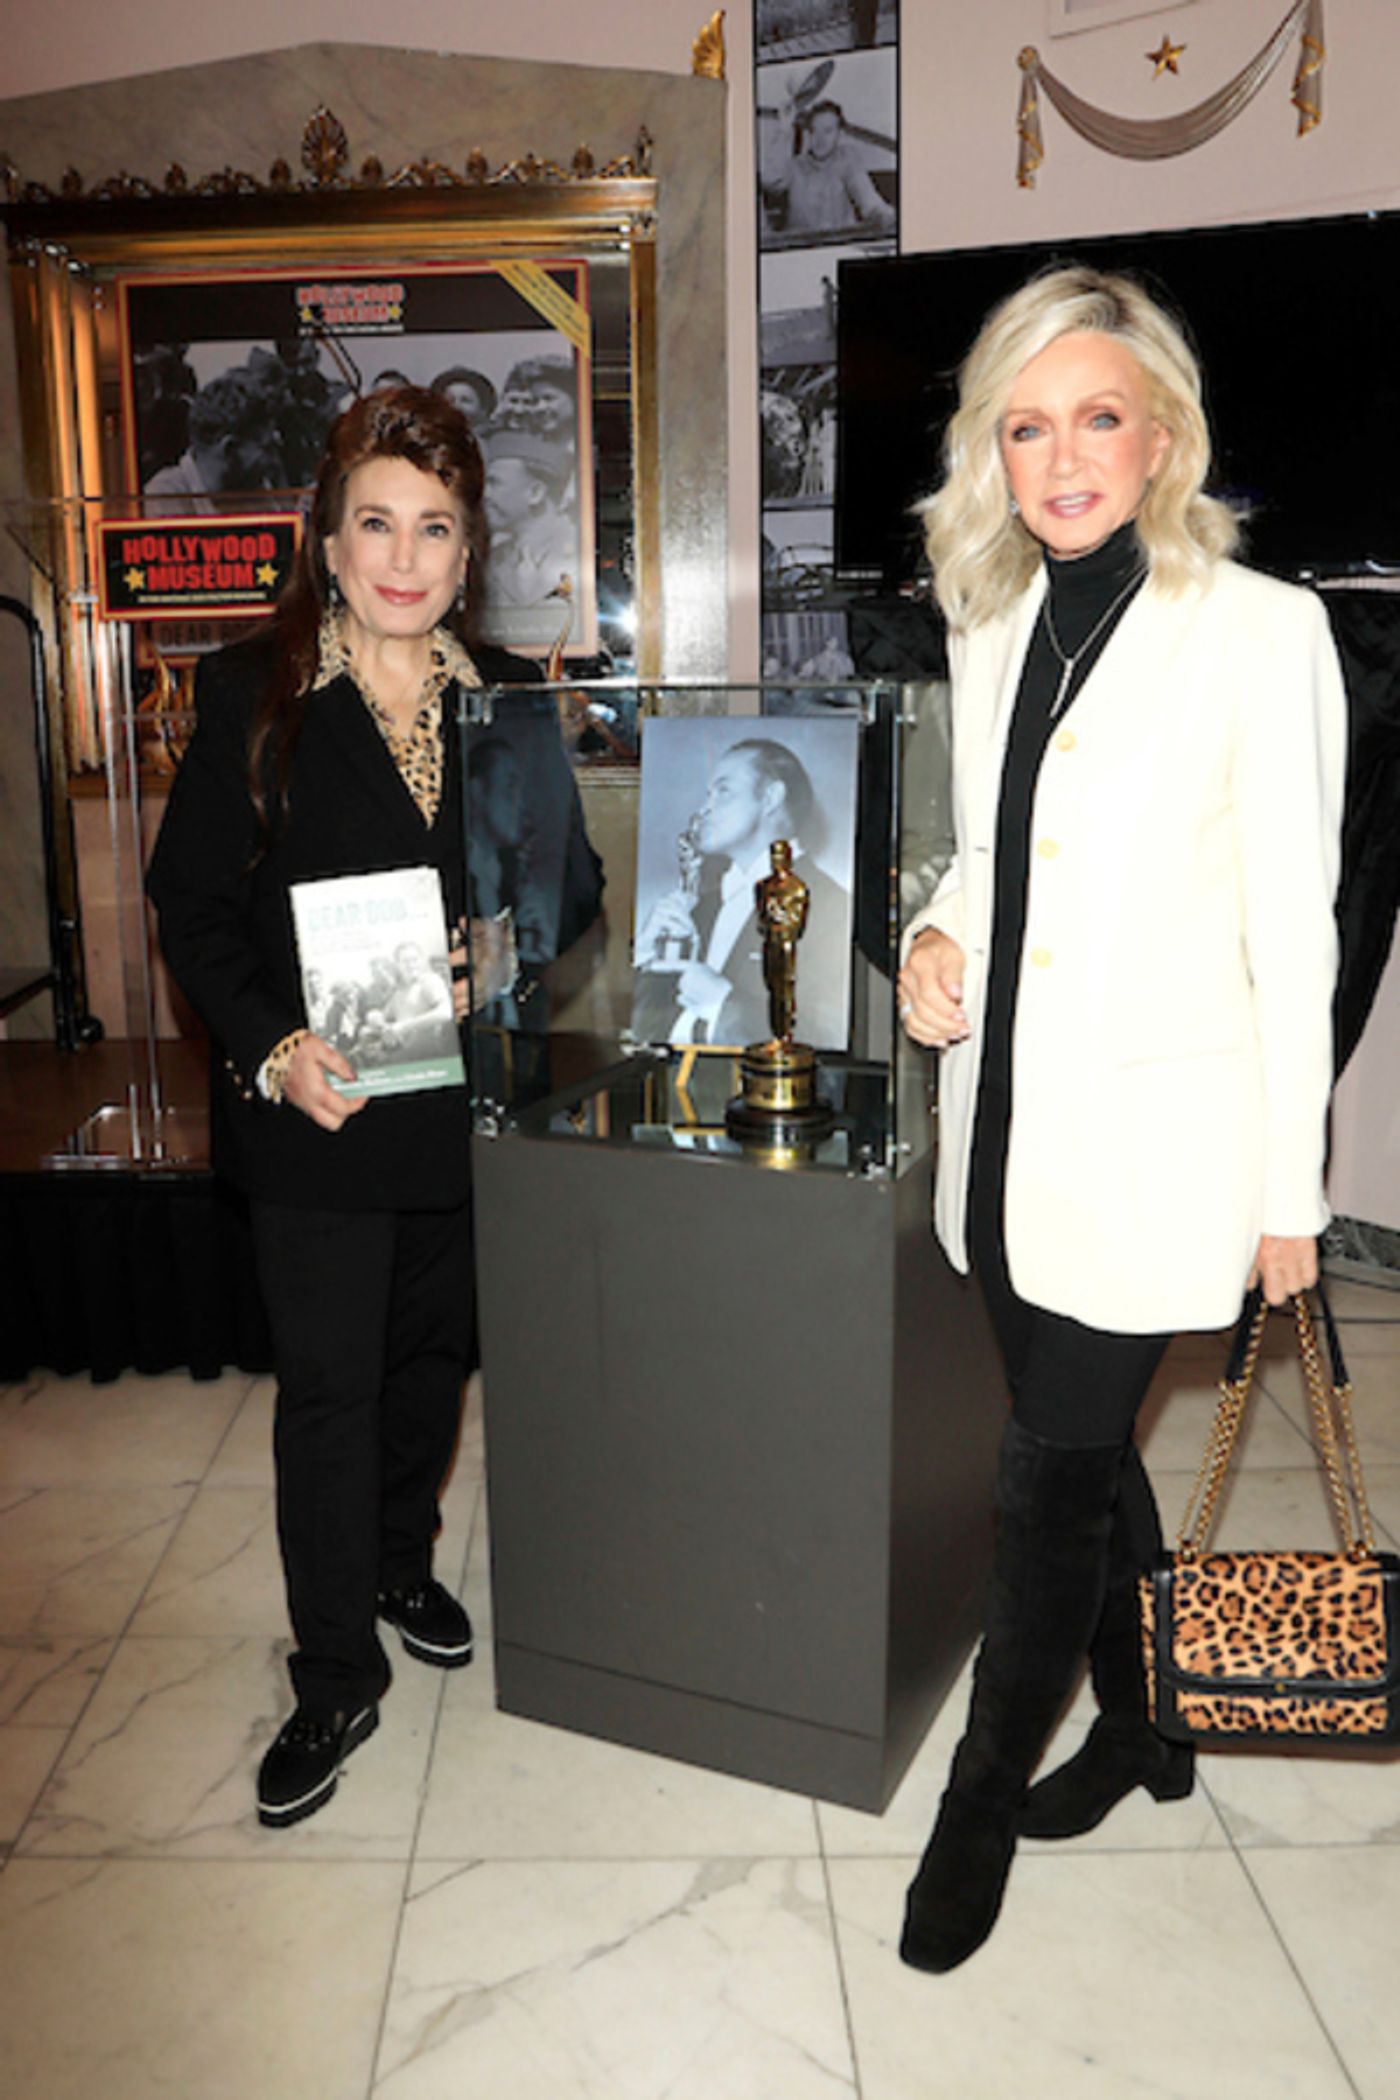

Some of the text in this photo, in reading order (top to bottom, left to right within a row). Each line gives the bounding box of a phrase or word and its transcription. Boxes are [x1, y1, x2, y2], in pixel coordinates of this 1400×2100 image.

[297, 284, 404, 305] HOLLYWOOD
[122, 533, 276, 564] HOLLYWOOD
[147, 563, 255, 591] MUSEUM
